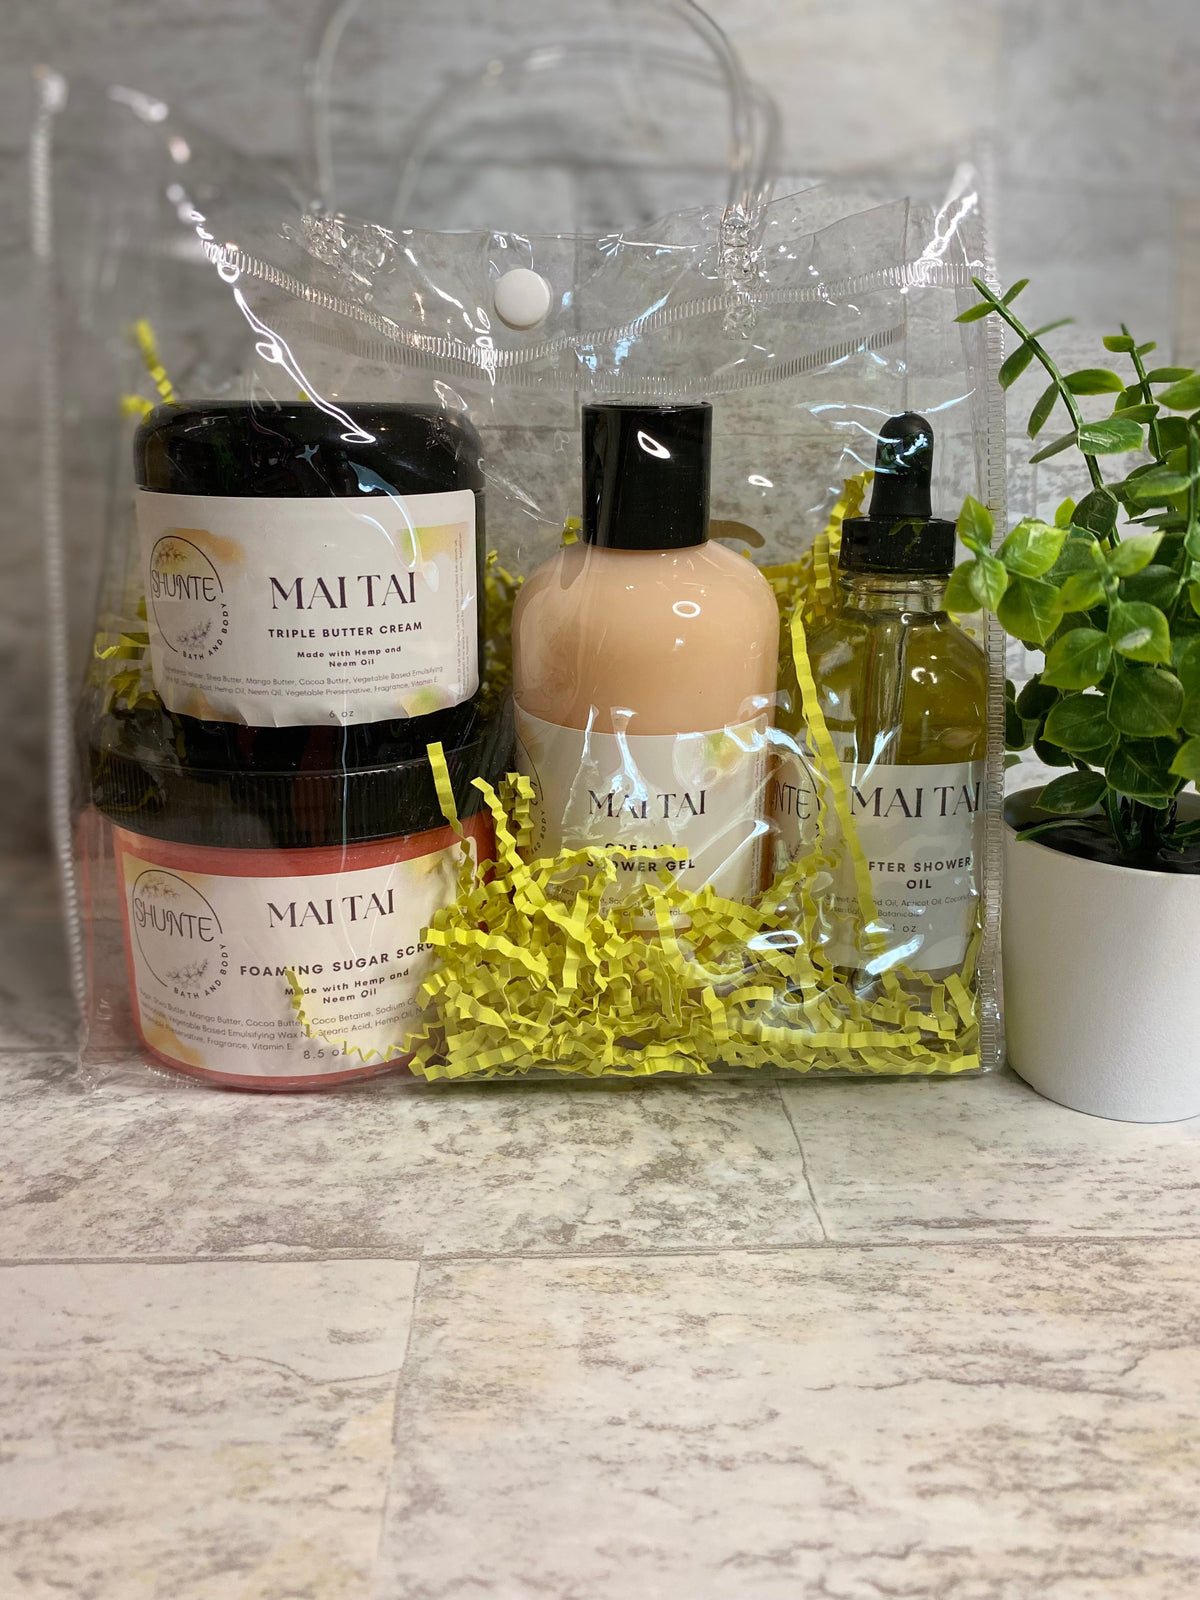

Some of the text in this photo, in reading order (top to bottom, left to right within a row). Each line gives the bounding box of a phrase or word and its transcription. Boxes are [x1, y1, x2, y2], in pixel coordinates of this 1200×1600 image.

[151, 569, 216, 602] SHUNTE
[269, 571, 416, 610] MAI TAI
[183, 603, 229, 660] BATH AND BODY
[268, 621, 422, 638] TRIPLE BUTTER CREAM
[355, 648, 381, 656] Hemp
[385, 646, 402, 654] and
[246, 678, 271, 686] Mango
[299, 678, 325, 686] Cocoa
[353, 674, 389, 685] Vegetable
[390, 671, 411, 680] Based
[329, 710, 336, 718] 6
[588, 789, 706, 819] MAI TAI
[850, 781, 981, 818] MAI TAI
[586, 859, 695, 872] SOWER GEL
[868, 856, 971, 873] FTER SHOWER
[906, 879, 932, 889] OIL
[134, 897, 214, 942] SHUNTE
[267, 889, 395, 928] MAI TAI
[902, 925, 917, 933] oz
[333, 953, 389, 972] SUGAR
[396, 942, 435, 959] SCRU
[174, 944, 229, 999] BATH AND BODY
[284, 968, 409, 996] Mde with Hemp and
[323, 987, 377, 1004] Neem Oil
[245, 1019, 275, 1027] Cocoa
[312, 1016, 336, 1025] Coco
[338, 1011, 374, 1022] Betaine,
[376, 1002, 406, 1015] Sodium
[202, 1026, 226, 1036] Based
[228, 1029, 275, 1041] Emulsifying
[277, 1031, 297, 1039] Wax
[375, 1017, 400, 1028] Hemp
[252, 1042, 285, 1050] Vitamin
[304, 1049, 325, 1060] 8.5
